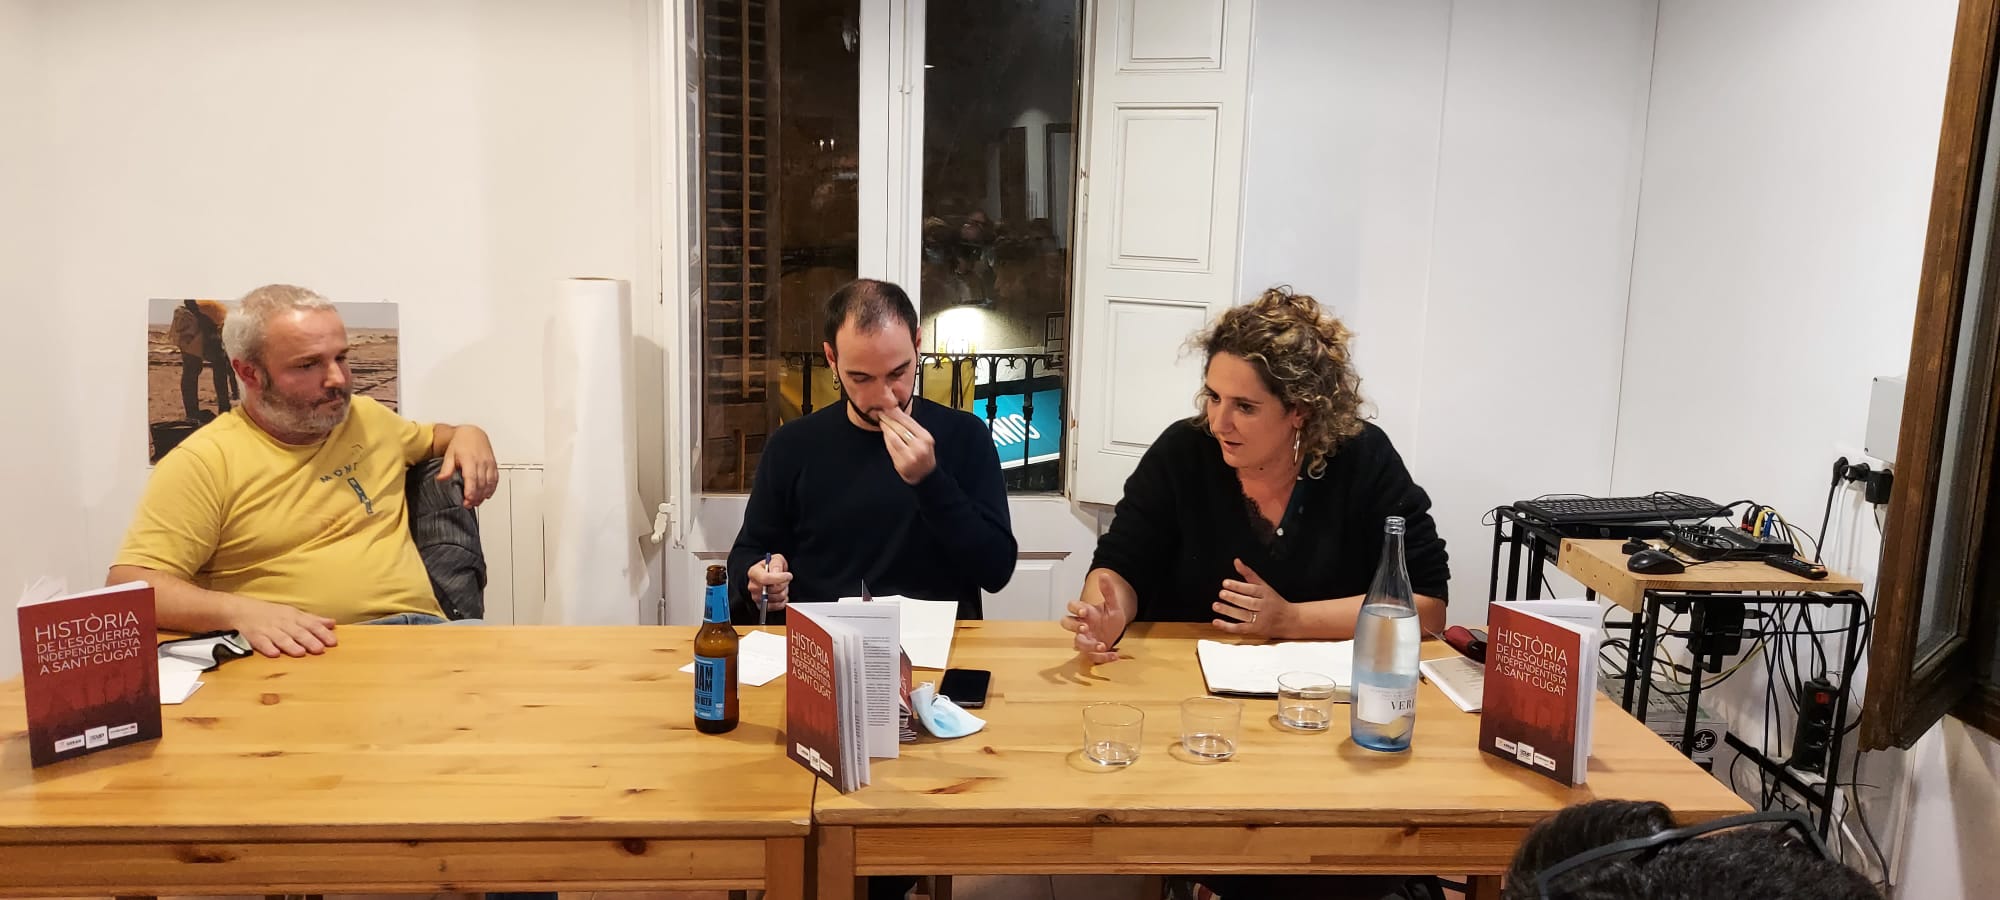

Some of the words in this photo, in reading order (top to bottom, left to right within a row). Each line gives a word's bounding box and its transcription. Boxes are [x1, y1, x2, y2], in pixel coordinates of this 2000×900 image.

[35, 611, 139, 642] HISTÒRIA
[36, 642, 56, 654] DE
[58, 627, 140, 650] L'ESQUERRA
[37, 638, 140, 664] INDEPENDENTISTA
[40, 665, 50, 676] A
[52, 656, 90, 673] SANT
[93, 647, 140, 664] CUGAT
[791, 629, 830, 670] HISTÒRIA
[791, 645, 800, 658] DE
[1496, 643, 1509, 656] DE
[1511, 647, 1567, 677] L'ESQUERRA
[1497, 626, 1568, 667] HISTÒRIA
[791, 666, 797, 677] A
[797, 668, 813, 687] SANT
[813, 680, 832, 701] CUGAT
[1495, 653, 1567, 687] INDEPENDENTISTA
[1495, 663, 1502, 673] A
[1504, 666, 1531, 683] SANT
[1532, 676, 1567, 697] CUGAT
